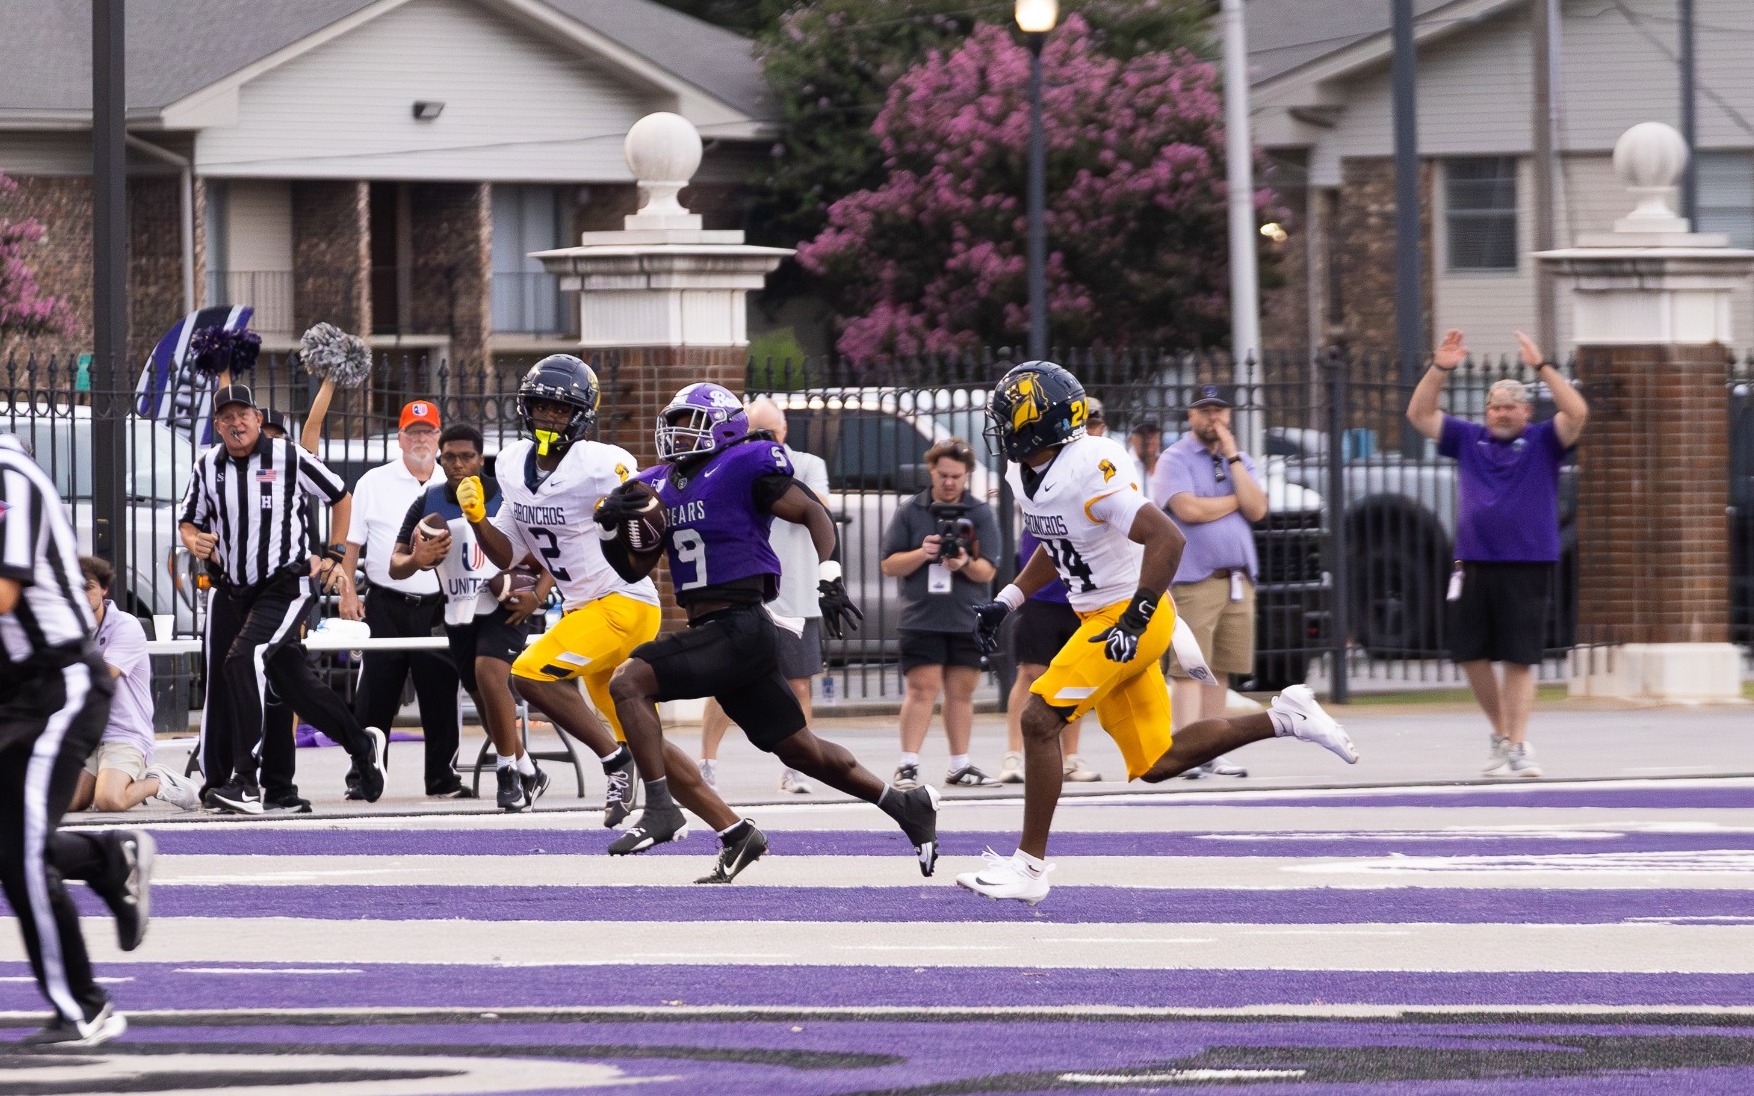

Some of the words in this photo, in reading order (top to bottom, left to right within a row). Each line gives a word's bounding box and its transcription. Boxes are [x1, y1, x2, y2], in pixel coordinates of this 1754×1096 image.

[261, 495, 272, 508] H
[513, 502, 566, 526] BRONCHOS
[528, 527, 572, 582] 2
[672, 528, 708, 591] 9
